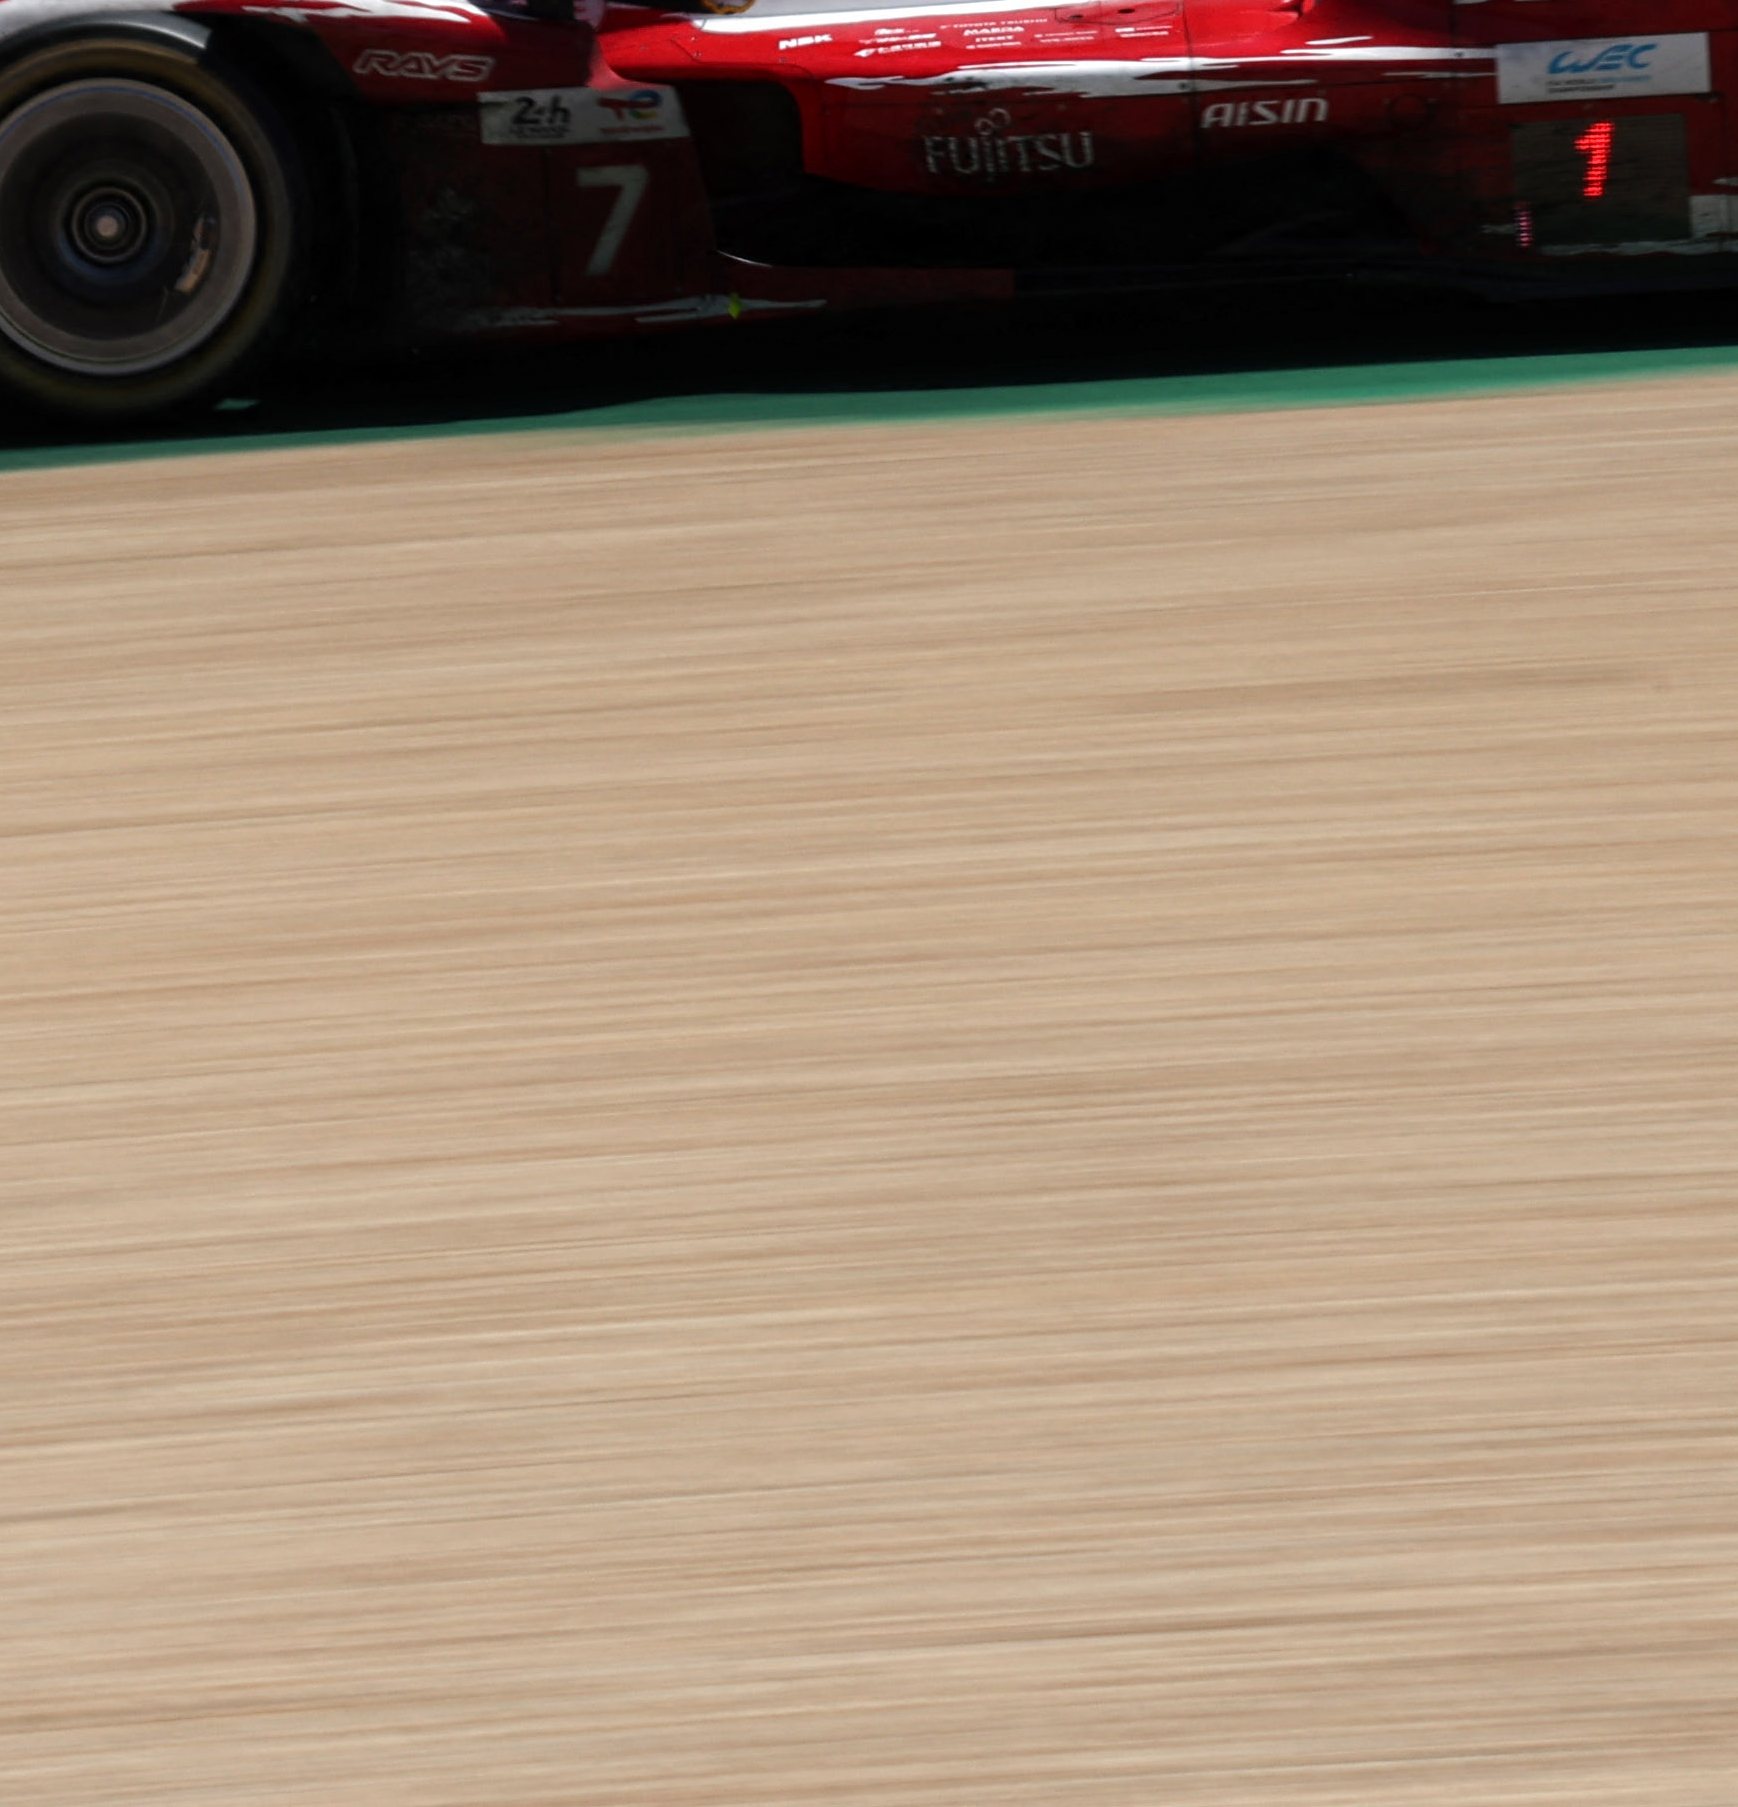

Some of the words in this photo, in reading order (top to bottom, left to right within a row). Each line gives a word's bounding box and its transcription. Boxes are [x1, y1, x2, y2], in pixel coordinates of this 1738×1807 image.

[352, 48, 495, 82] RAYS
[1548, 43, 1658, 74] WEC
[923, 107, 1096, 184] FUJITSU
[1572, 120, 1615, 200] 1
[576, 164, 649, 277] 7
